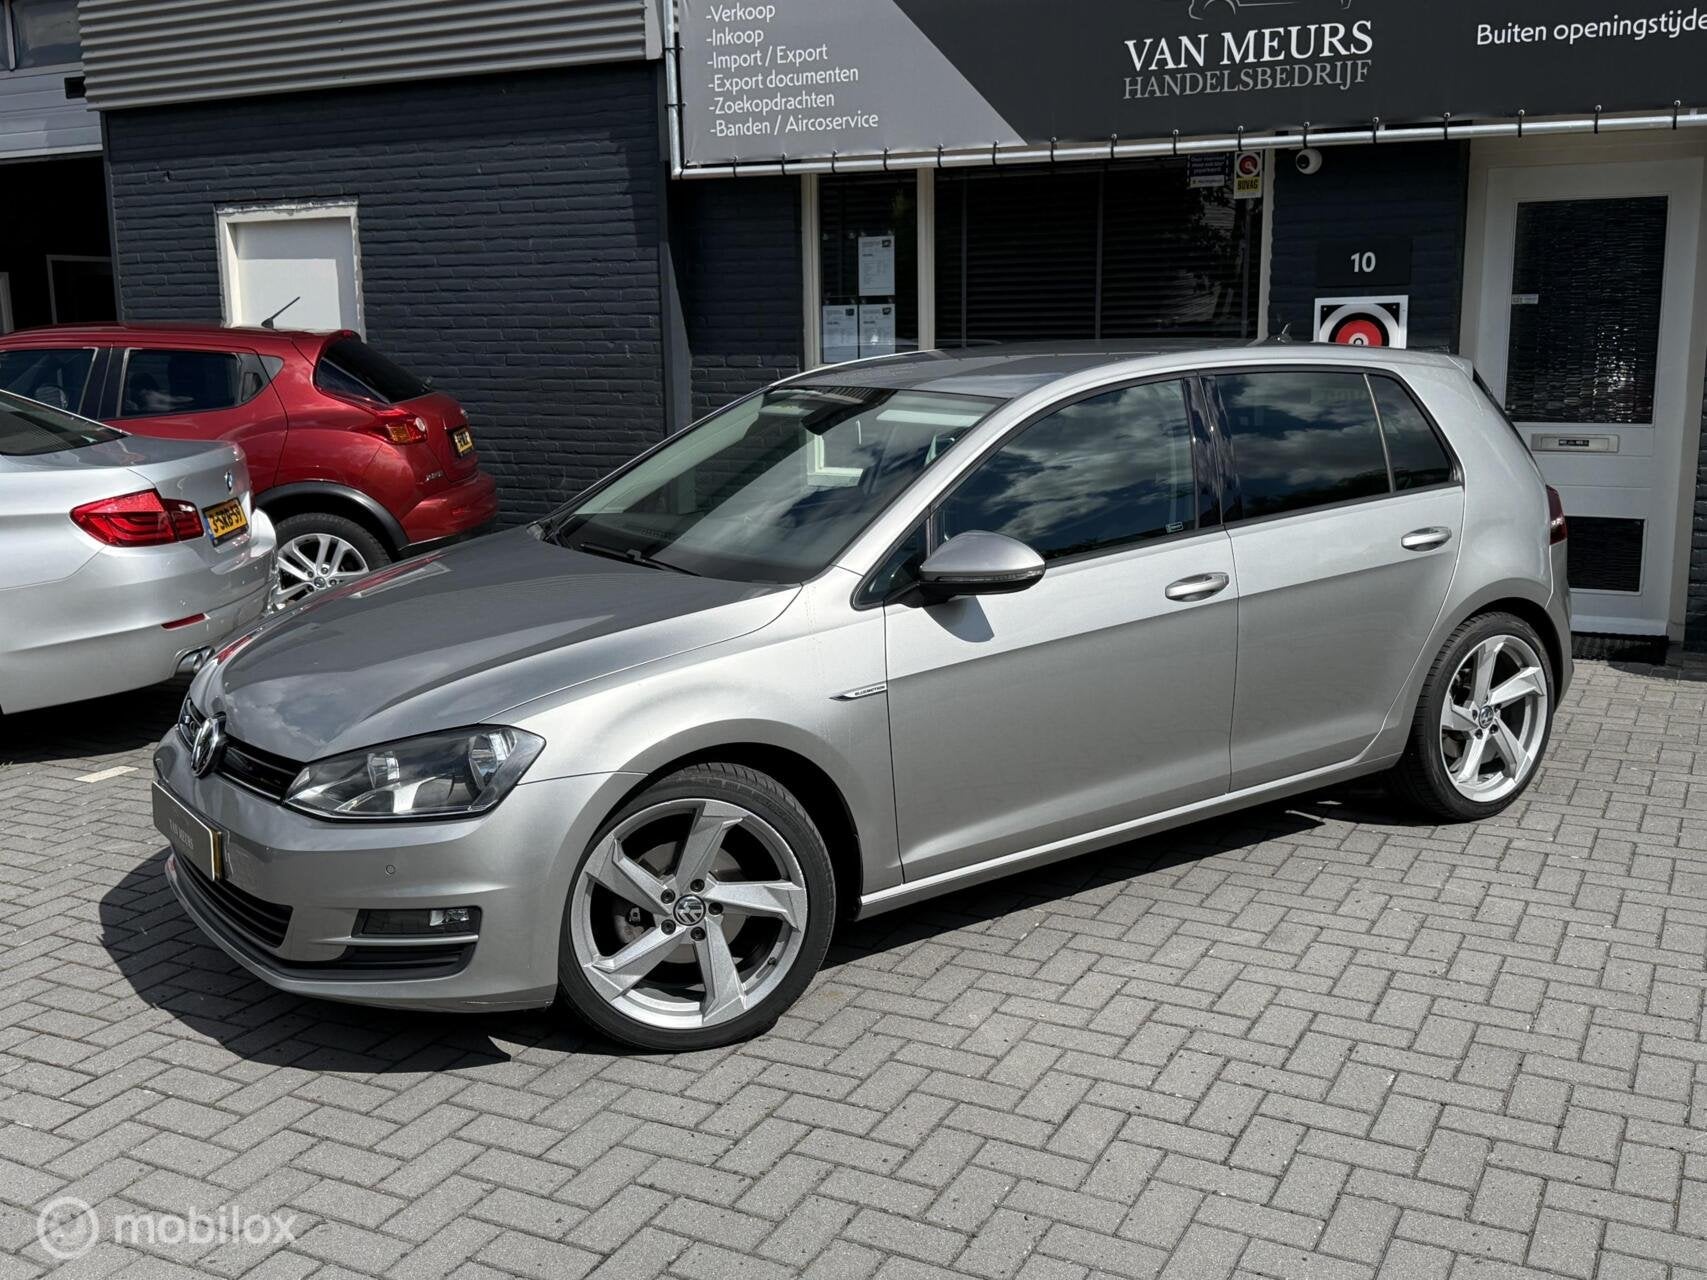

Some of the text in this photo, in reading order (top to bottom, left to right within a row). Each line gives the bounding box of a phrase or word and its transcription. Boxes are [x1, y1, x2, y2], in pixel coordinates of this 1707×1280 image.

[706, 3, 776, 23] -Verkoop
[706, 27, 764, 46] -Inkoop
[1124, 20, 1373, 72] VAN MEURS
[1477, 23, 1547, 45] Buiten
[707, 49, 762, 71] -Import
[776, 43, 828, 66] Export
[708, 67, 859, 94] -Export documenten
[1123, 59, 1372, 99] HANDELSBEDRIJF
[709, 91, 835, 116] -Zoekopdrachten
[710, 119, 771, 137] -Banden
[785, 111, 879, 133] Aircoservice
[1350, 251, 1376, 273] 10
